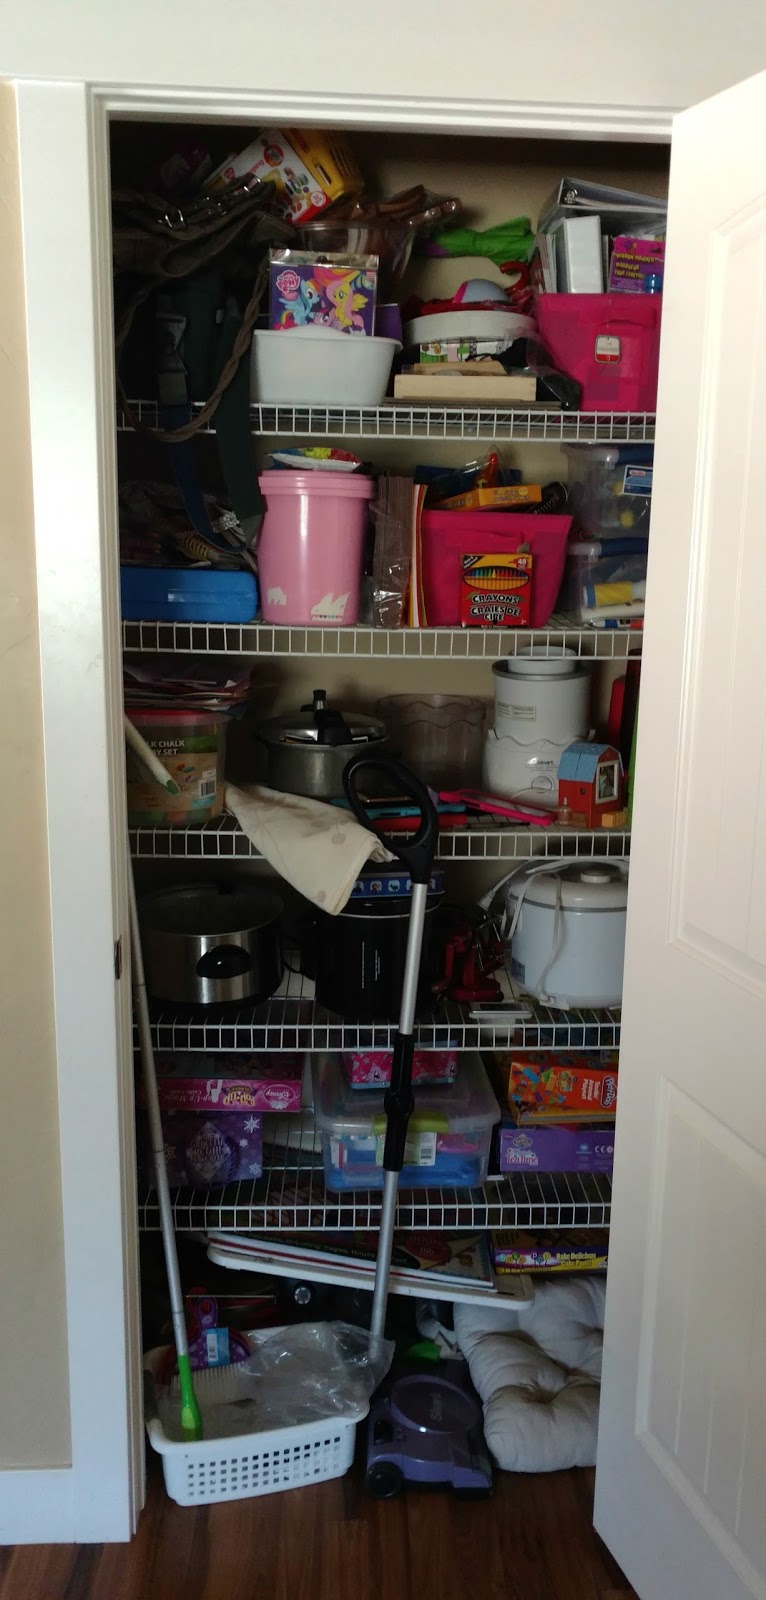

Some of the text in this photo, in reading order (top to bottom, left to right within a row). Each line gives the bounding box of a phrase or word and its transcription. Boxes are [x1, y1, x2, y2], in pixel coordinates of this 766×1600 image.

[472, 594, 519, 604] CRAYONS
[470, 605, 521, 617] CRAIES DE
[484, 613, 505, 622] CIRE
[158, 740, 185, 748] CHALK
[163, 748, 178, 756] SET
[264, 1089, 289, 1100] Disney
